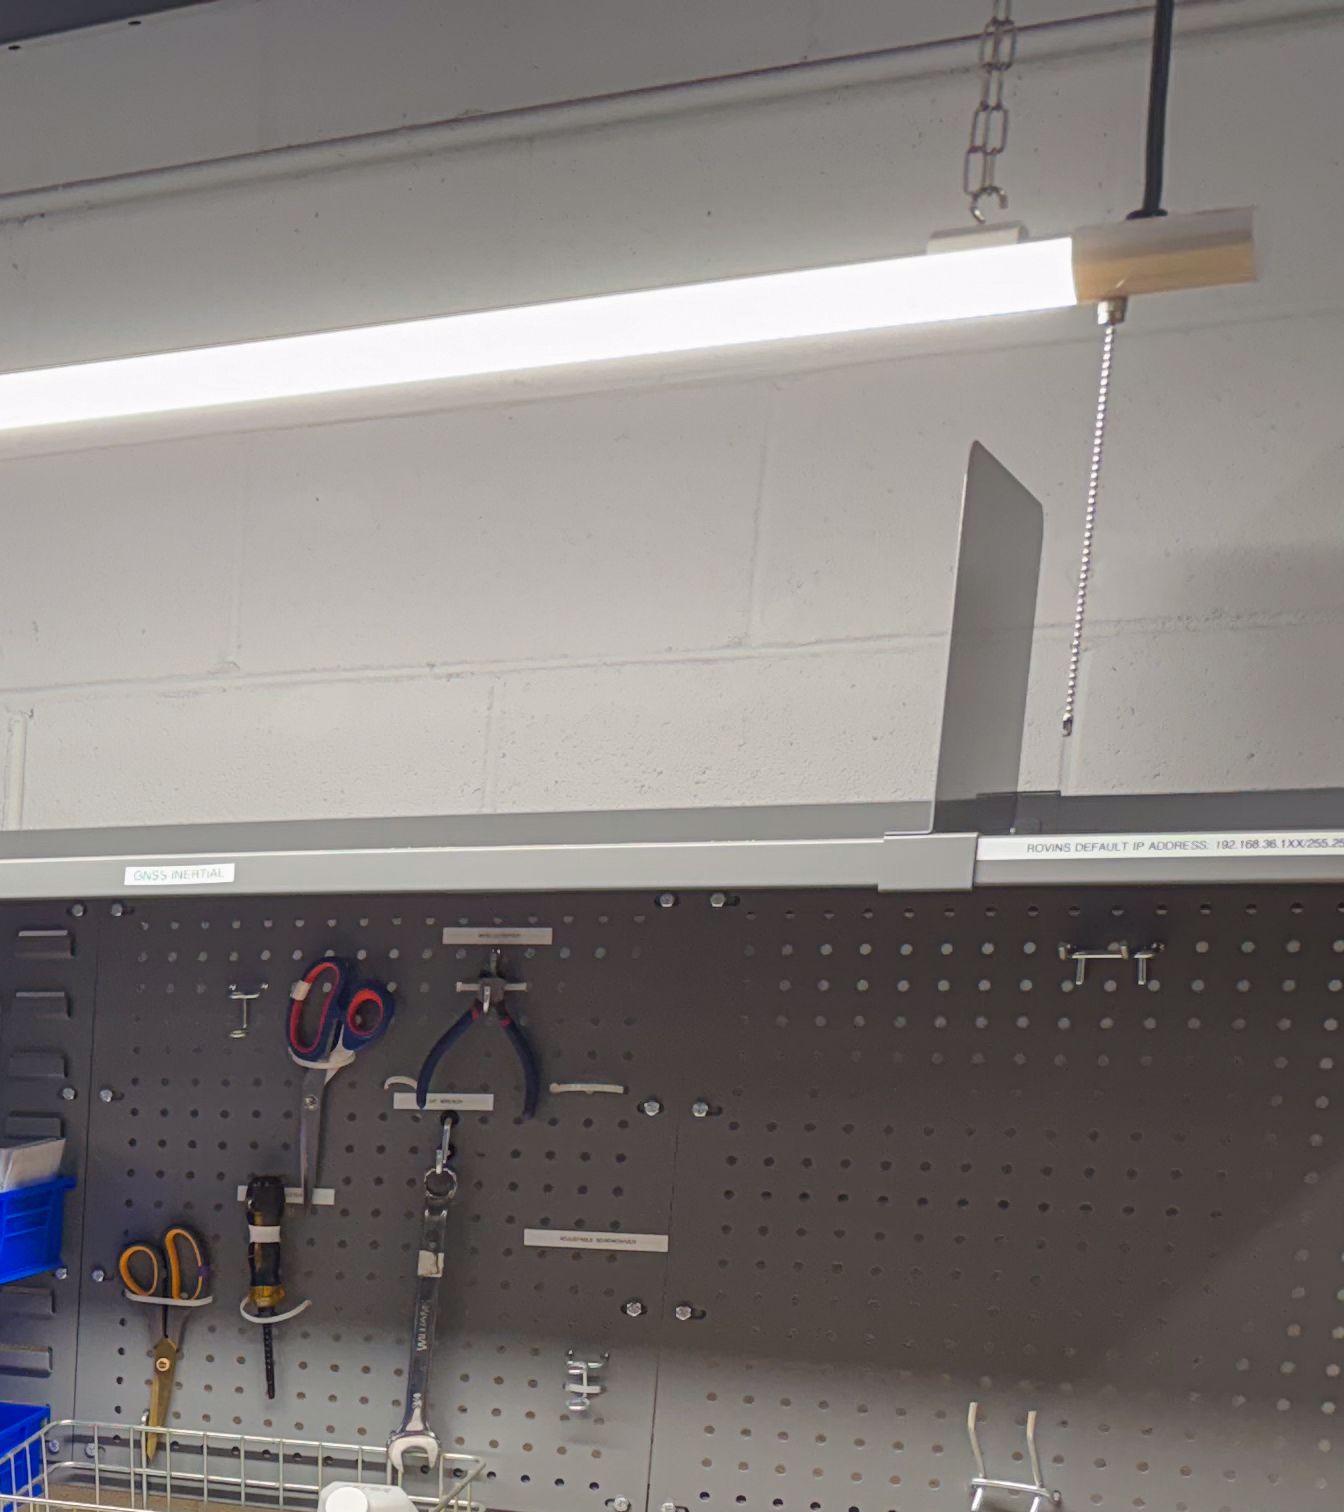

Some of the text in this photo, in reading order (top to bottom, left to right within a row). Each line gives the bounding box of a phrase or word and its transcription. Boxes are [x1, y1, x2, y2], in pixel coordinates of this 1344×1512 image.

[1026, 841, 1072, 853] ROVINS
[1074, 840, 1129, 853] DEFAULT
[1132, 840, 1146, 852] IP
[133, 867, 226, 881] GNSS INERTIAL
